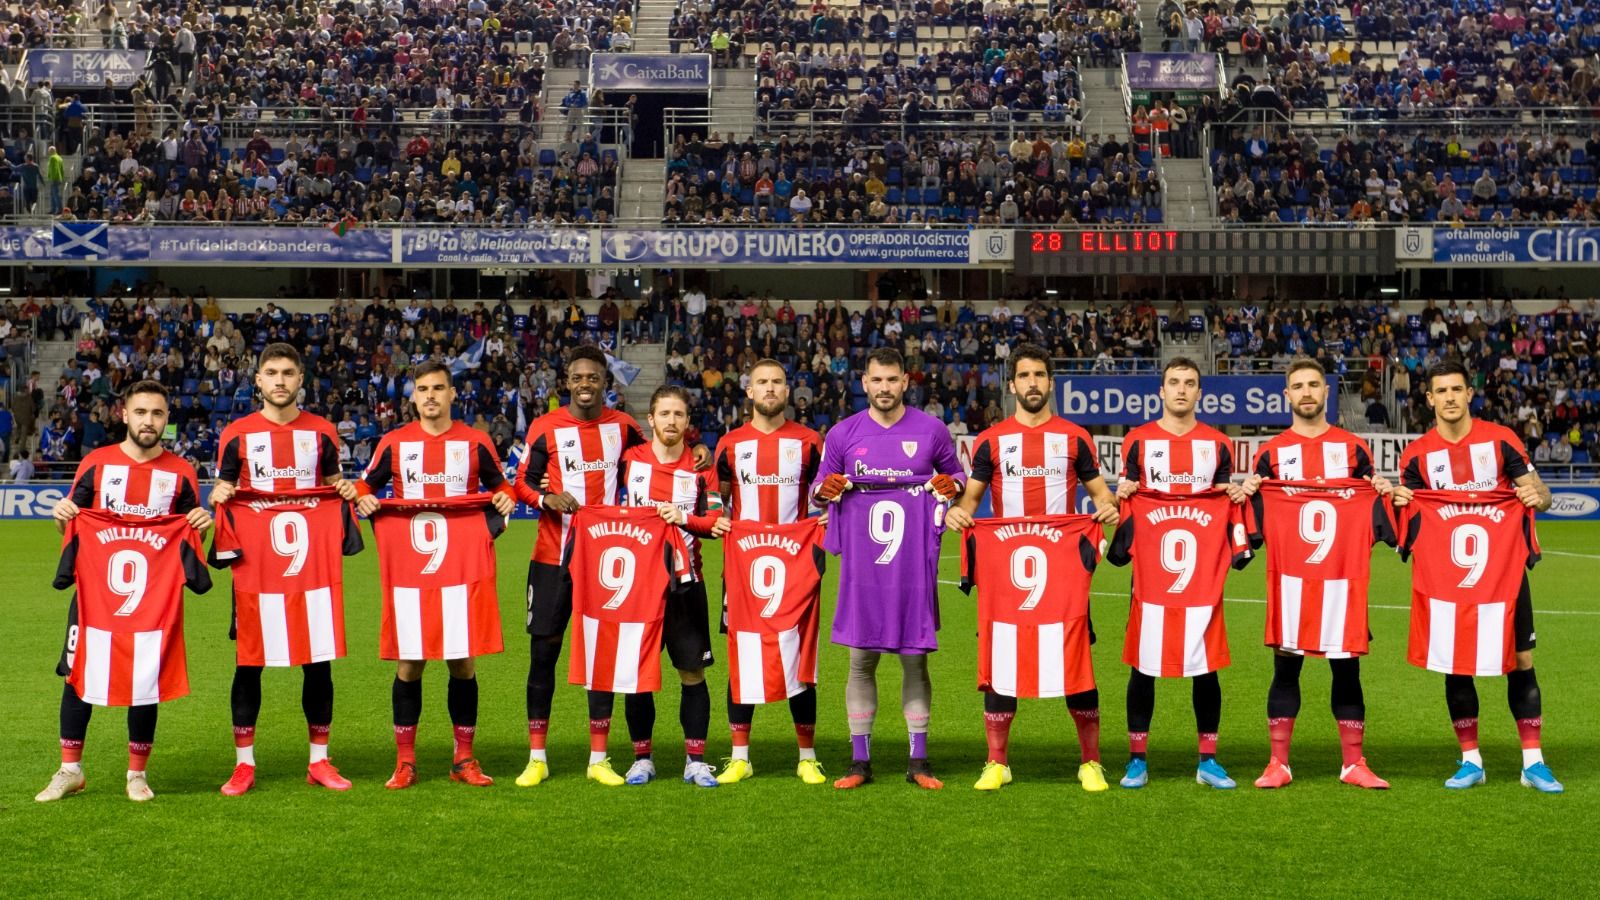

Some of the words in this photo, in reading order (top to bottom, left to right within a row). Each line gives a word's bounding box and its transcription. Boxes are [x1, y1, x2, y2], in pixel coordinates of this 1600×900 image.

[73, 71, 100, 83] Piso
[623, 63, 704, 80] CaixaBank
[655, 231, 739, 257] GRUPO
[745, 231, 845, 257] FUMERO
[849, 233, 910, 246] OPERADOR
[912, 231, 970, 246] LOGÍSTICO
[1031, 232, 1062, 252] 28
[1081, 232, 1178, 252] ELLIOT
[1475, 241, 1490, 252] de
[438, 253, 461, 262] Canal
[471, 253, 493, 262] radio
[568, 252, 584, 263] FM
[850, 247, 969, 260] www.grupofumero.es
[1437, 501, 1506, 524] WILLIAMS
[1550, 496, 1585, 511] Ford
[1147, 505, 1212, 527] WILLIAMS
[96, 527, 167, 551] WILLIAMS
[270, 511, 309, 577] 9
[410, 511, 448, 574] 9
[588, 521, 653, 546] WILLIAMS
[869, 500, 905, 564] 9
[994, 523, 1063, 544] WILLIAMS
[1300, 500, 1337, 564] 9
[737, 533, 801, 556] WILLIAMS
[1451, 524, 1489, 588] 9
[1161, 528, 1197, 593] 9
[107, 549, 148, 617] 9
[599, 546, 636, 610] 9
[750, 555, 786, 618] 9
[1010, 546, 1048, 611] 9
